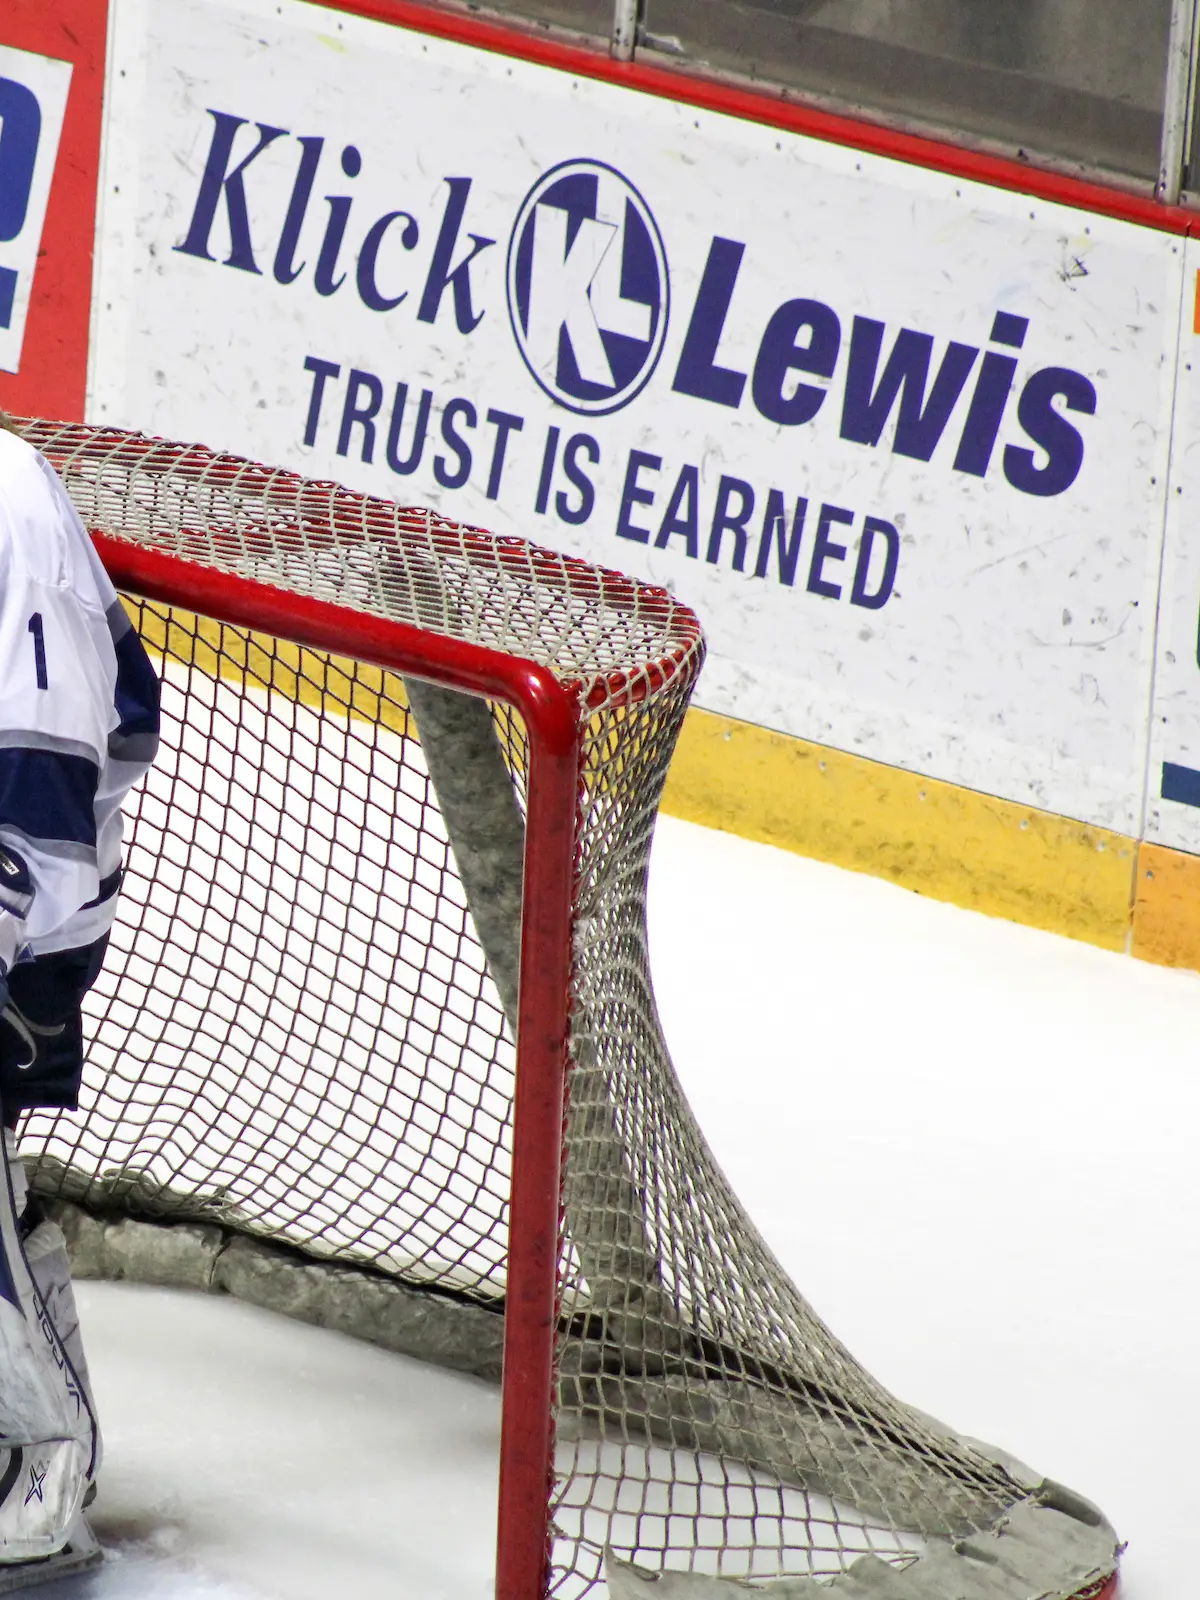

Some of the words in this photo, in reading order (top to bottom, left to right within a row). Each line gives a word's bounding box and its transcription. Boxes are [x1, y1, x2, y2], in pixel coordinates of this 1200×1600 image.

[172, 109, 497, 334] Klick
[671, 236, 1097, 497] Lewis
[301, 356, 522, 499] TRUST
[535, 425, 600, 525] IS
[615, 449, 901, 609] EARNED
[28, 612, 48, 690] 1
